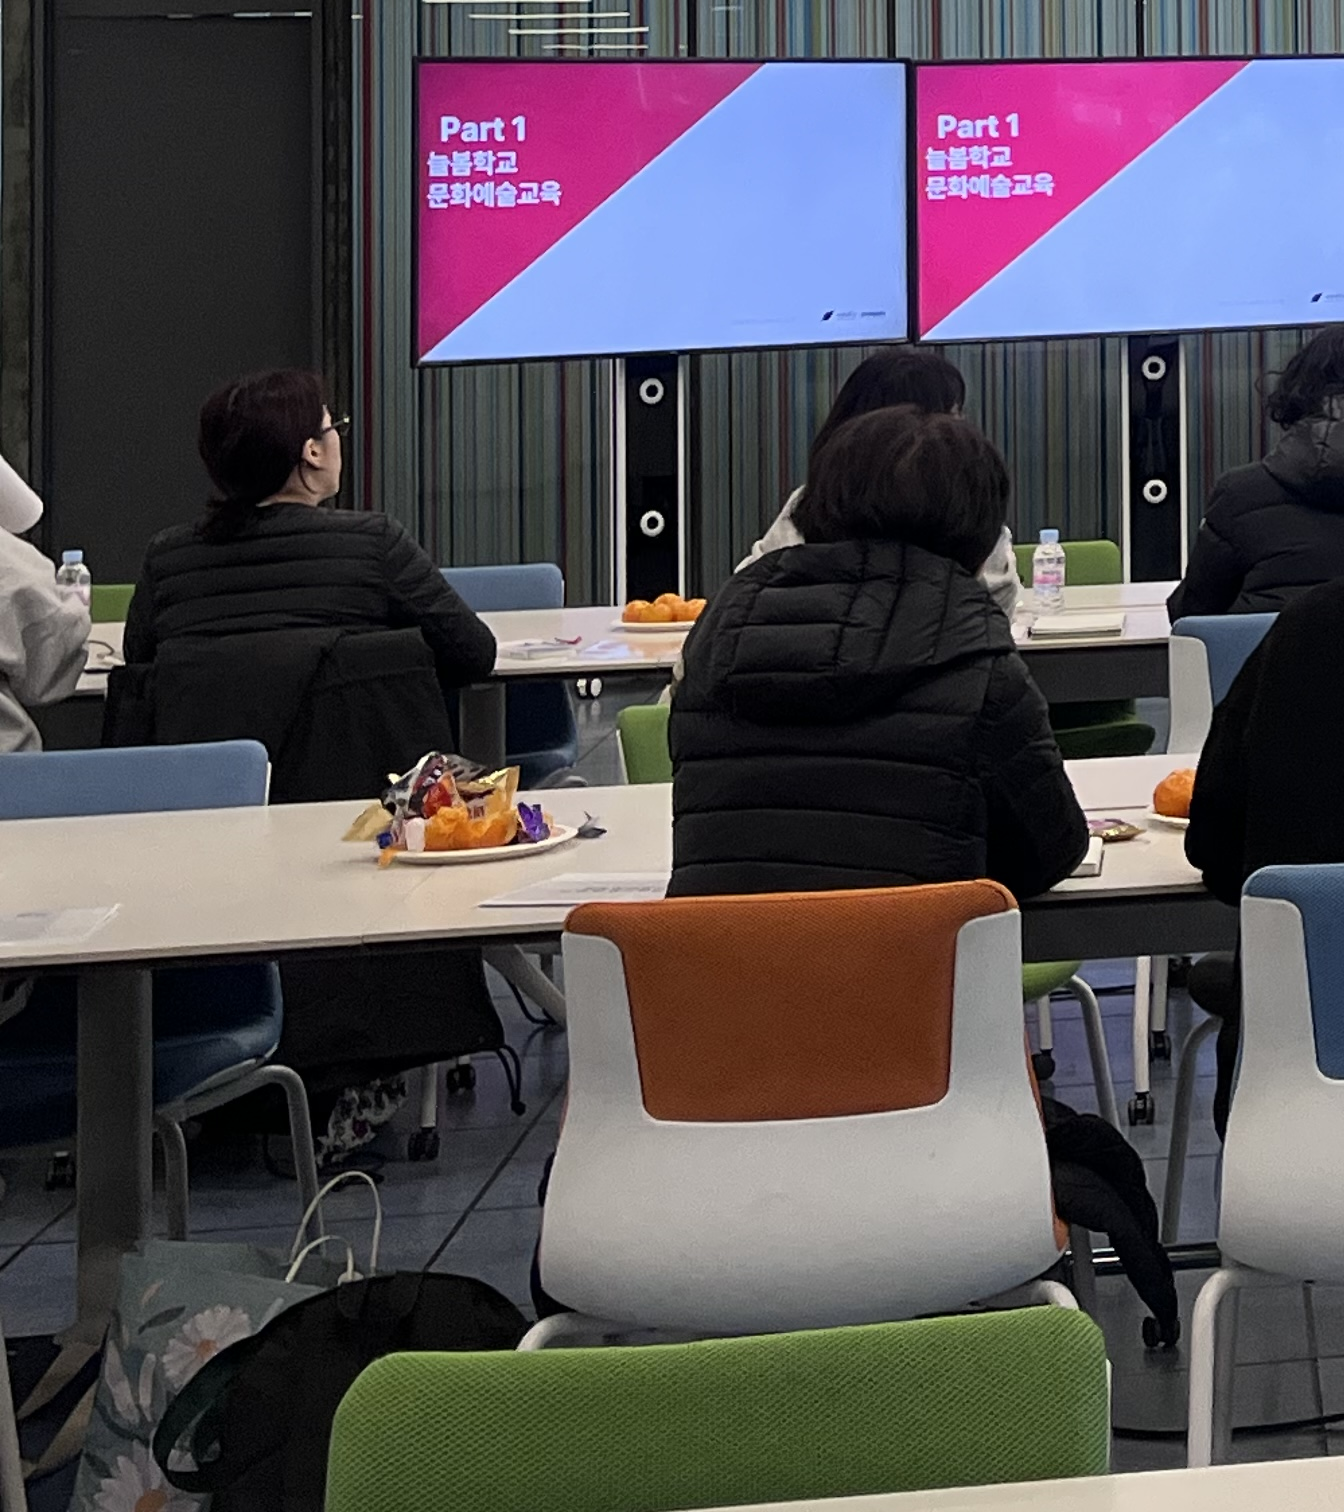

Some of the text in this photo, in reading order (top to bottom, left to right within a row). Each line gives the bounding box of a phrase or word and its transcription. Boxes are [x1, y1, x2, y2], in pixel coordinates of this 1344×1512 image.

[441, 115, 526, 143] Part 1
[938, 112, 1019, 139] Part 1
[427, 149, 519, 177] 늘봄학교
[925, 144, 1013, 171] 늘봄학교
[427, 180, 562, 209] 문화예술교육
[925, 173, 1055, 200] 문화예술교육
